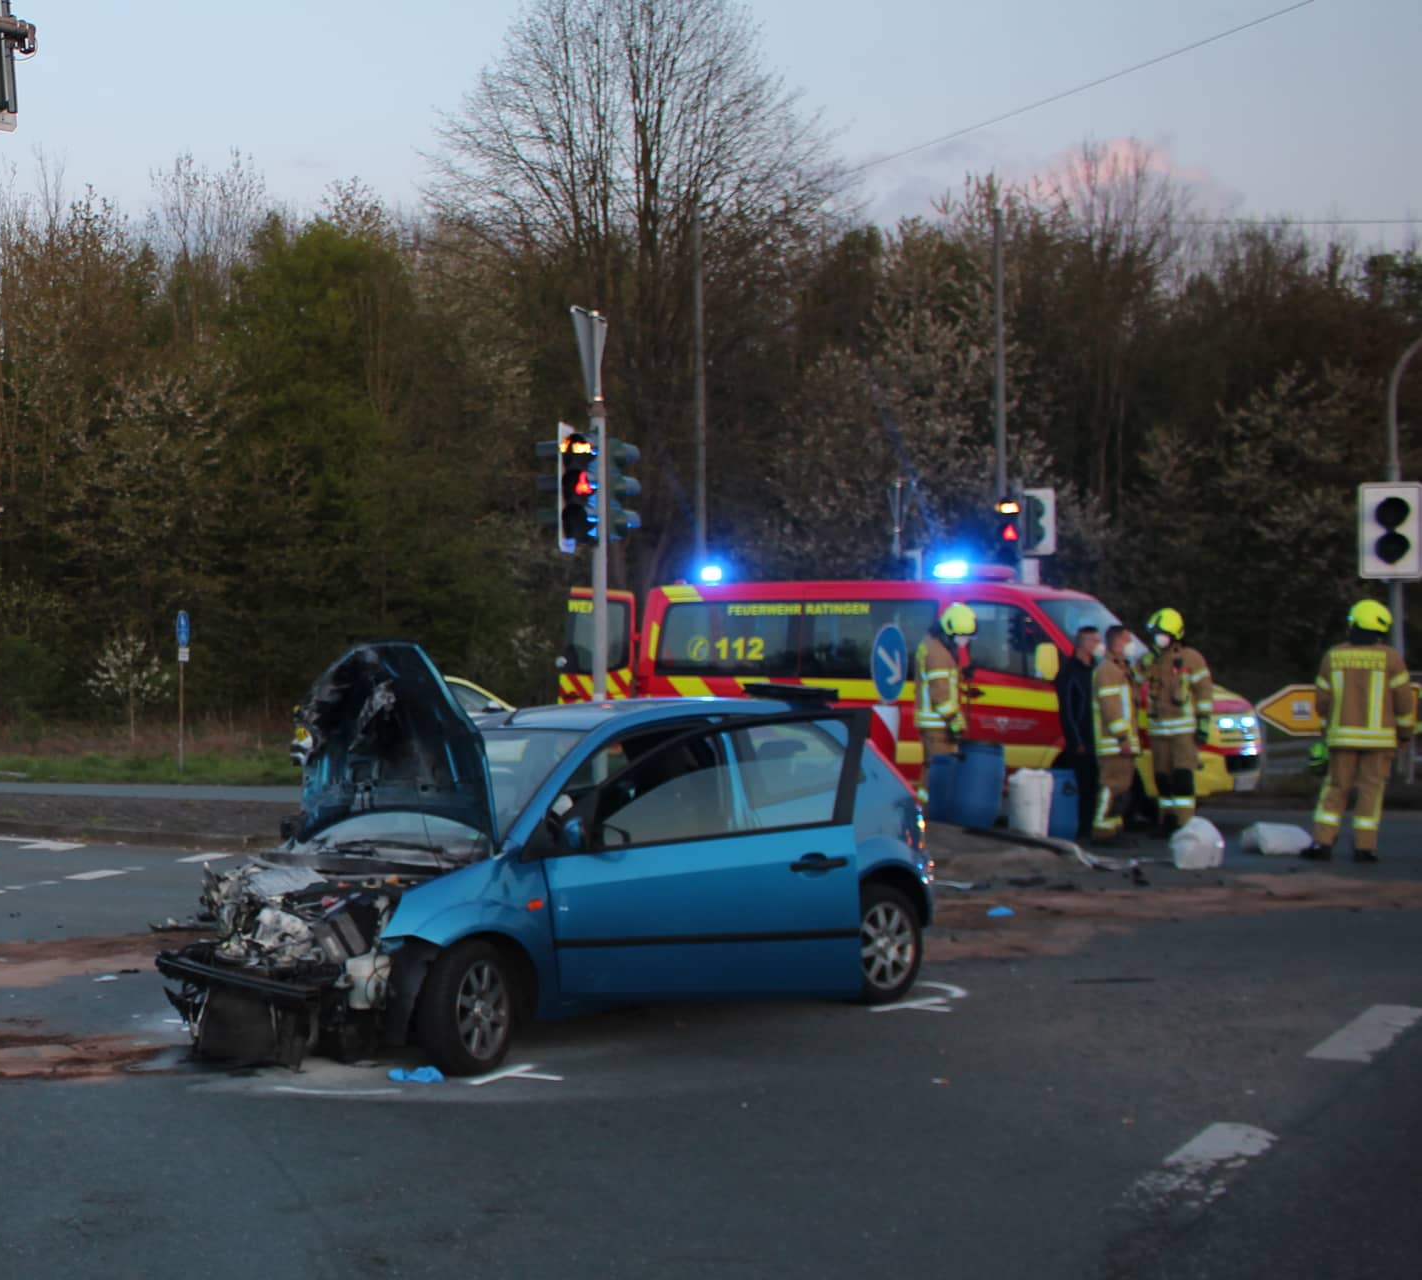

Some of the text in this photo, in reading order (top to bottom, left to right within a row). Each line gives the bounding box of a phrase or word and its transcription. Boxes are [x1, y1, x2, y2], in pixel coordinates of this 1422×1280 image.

[728, 602, 869, 616] FEUERWEHR RATINGEN
[714, 636, 765, 660] 112
